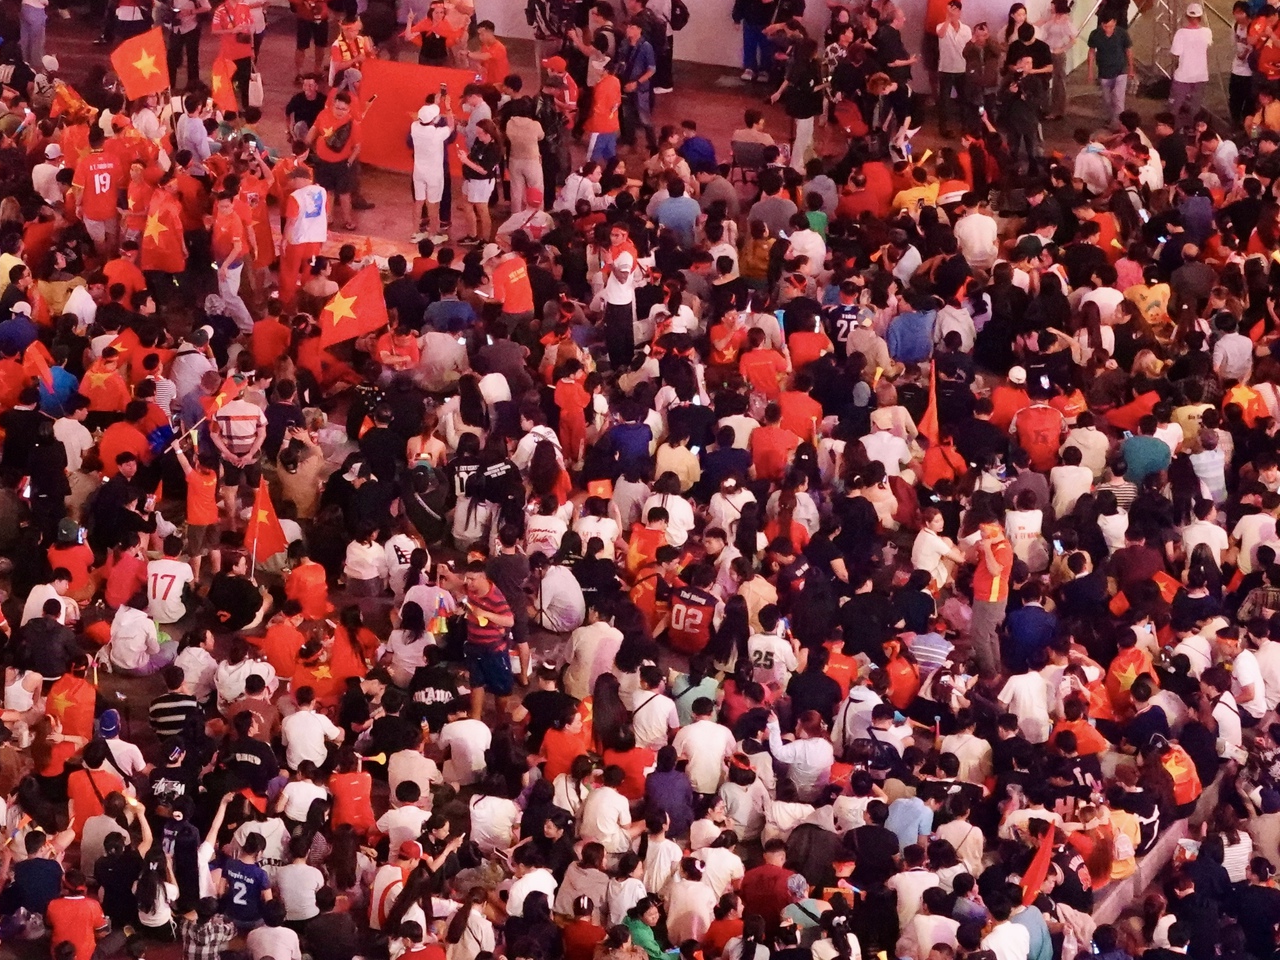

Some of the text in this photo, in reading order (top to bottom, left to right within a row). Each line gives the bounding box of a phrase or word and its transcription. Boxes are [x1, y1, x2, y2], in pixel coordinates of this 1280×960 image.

[94, 172, 111, 195] 19
[151, 572, 176, 601] 17
[671, 603, 703, 633] 02
[753, 649, 775, 669] 25
[233, 881, 247, 905] 2
